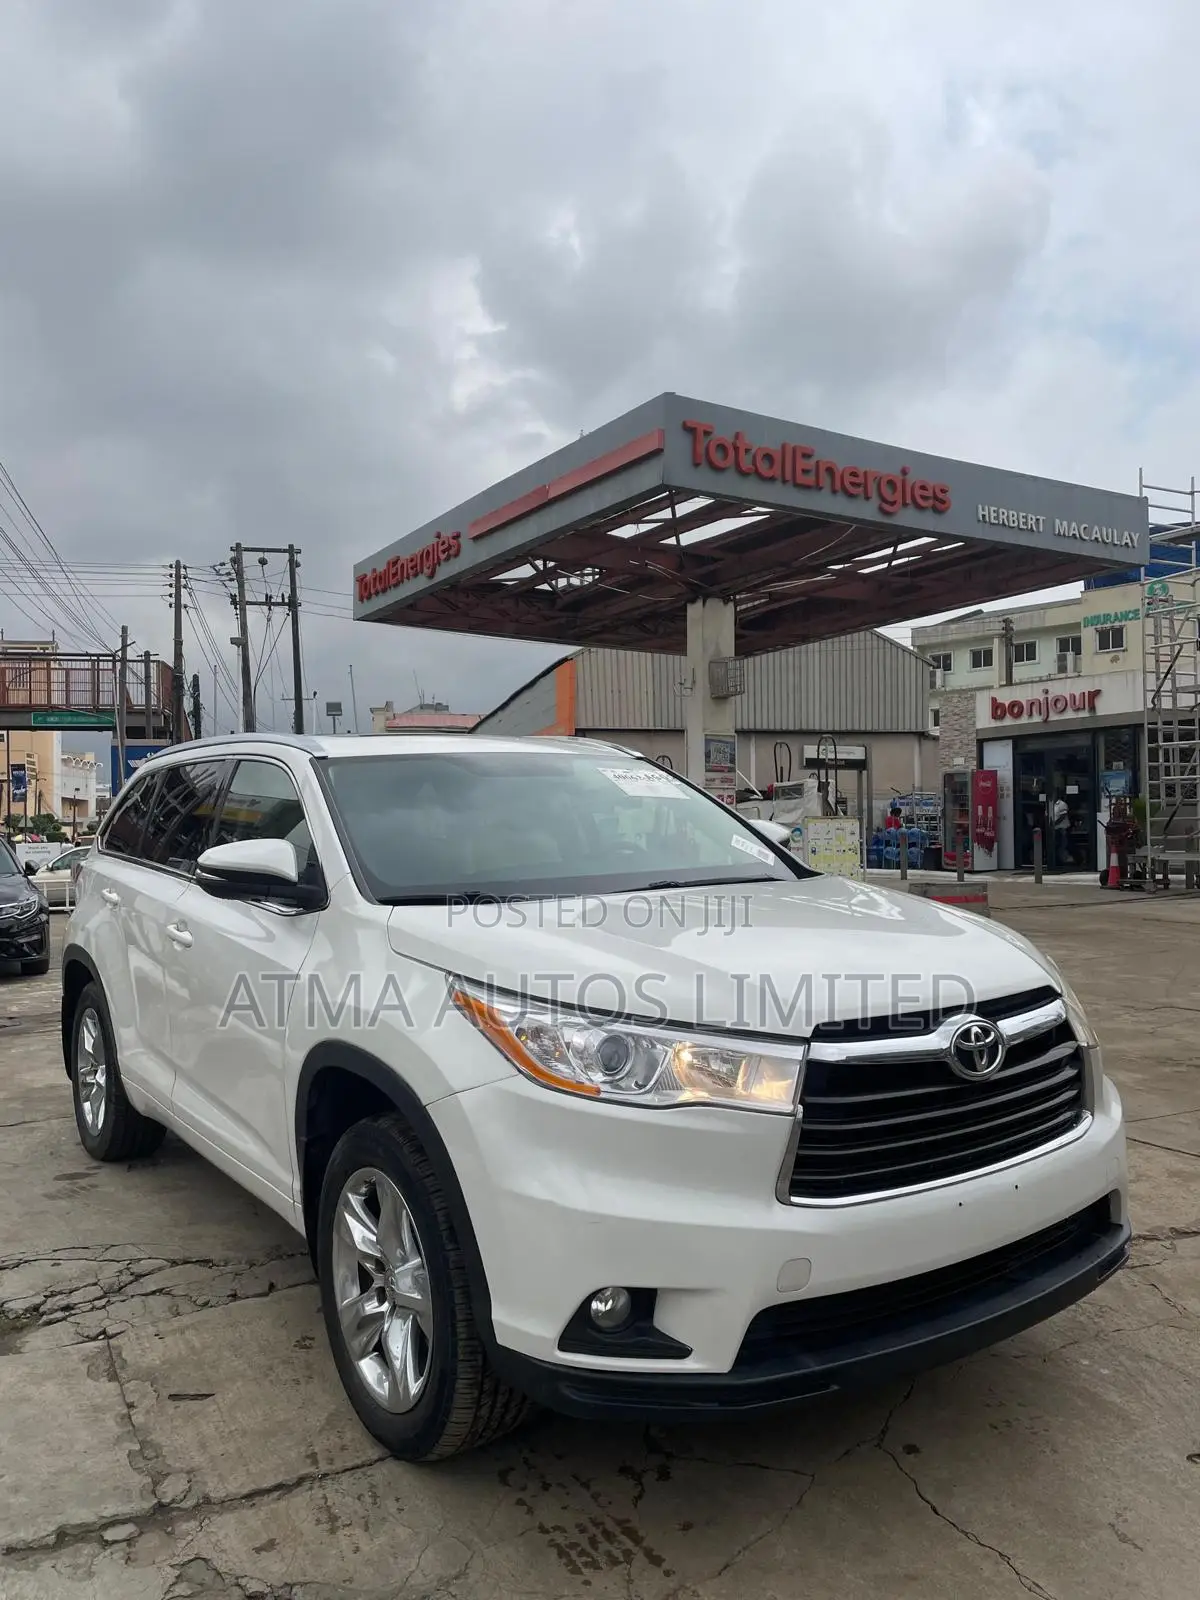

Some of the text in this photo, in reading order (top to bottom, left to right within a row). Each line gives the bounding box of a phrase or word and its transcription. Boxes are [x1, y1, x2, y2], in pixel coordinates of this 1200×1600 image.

[684, 419, 951, 515] TotalEnergies
[977, 503, 1140, 549] HERBERT MACAULAY
[355, 530, 462, 602] TotalEnergies
[1083, 608, 1141, 628] INSURANCE
[991, 689, 1102, 722] bonjour
